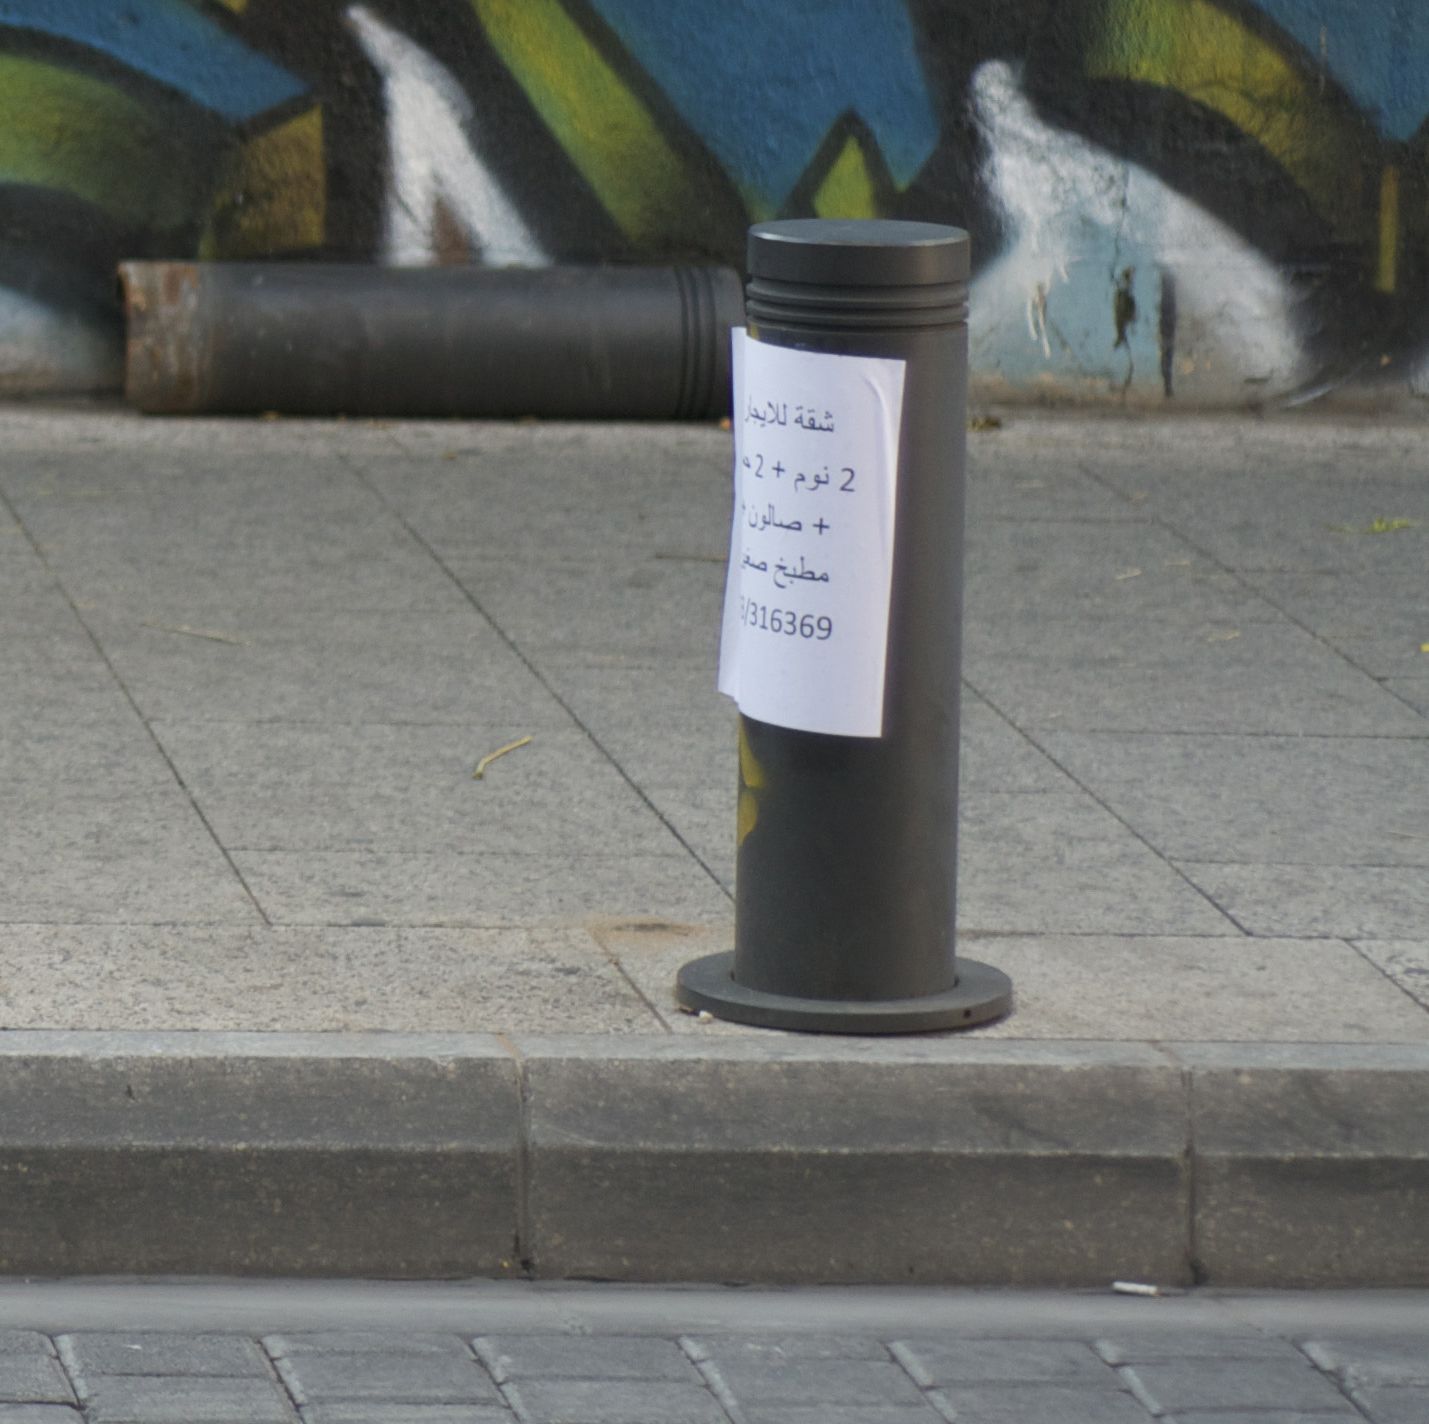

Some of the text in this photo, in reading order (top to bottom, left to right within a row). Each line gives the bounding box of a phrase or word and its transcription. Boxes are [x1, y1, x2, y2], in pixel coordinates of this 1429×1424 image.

[793, 404, 834, 433] شقة
[794, 465, 830, 493] نوم
[839, 466, 856, 493] 2
[747, 502, 802, 532] صالون
[812, 516, 830, 536] +
[772, 555, 830, 590] مطبخ
